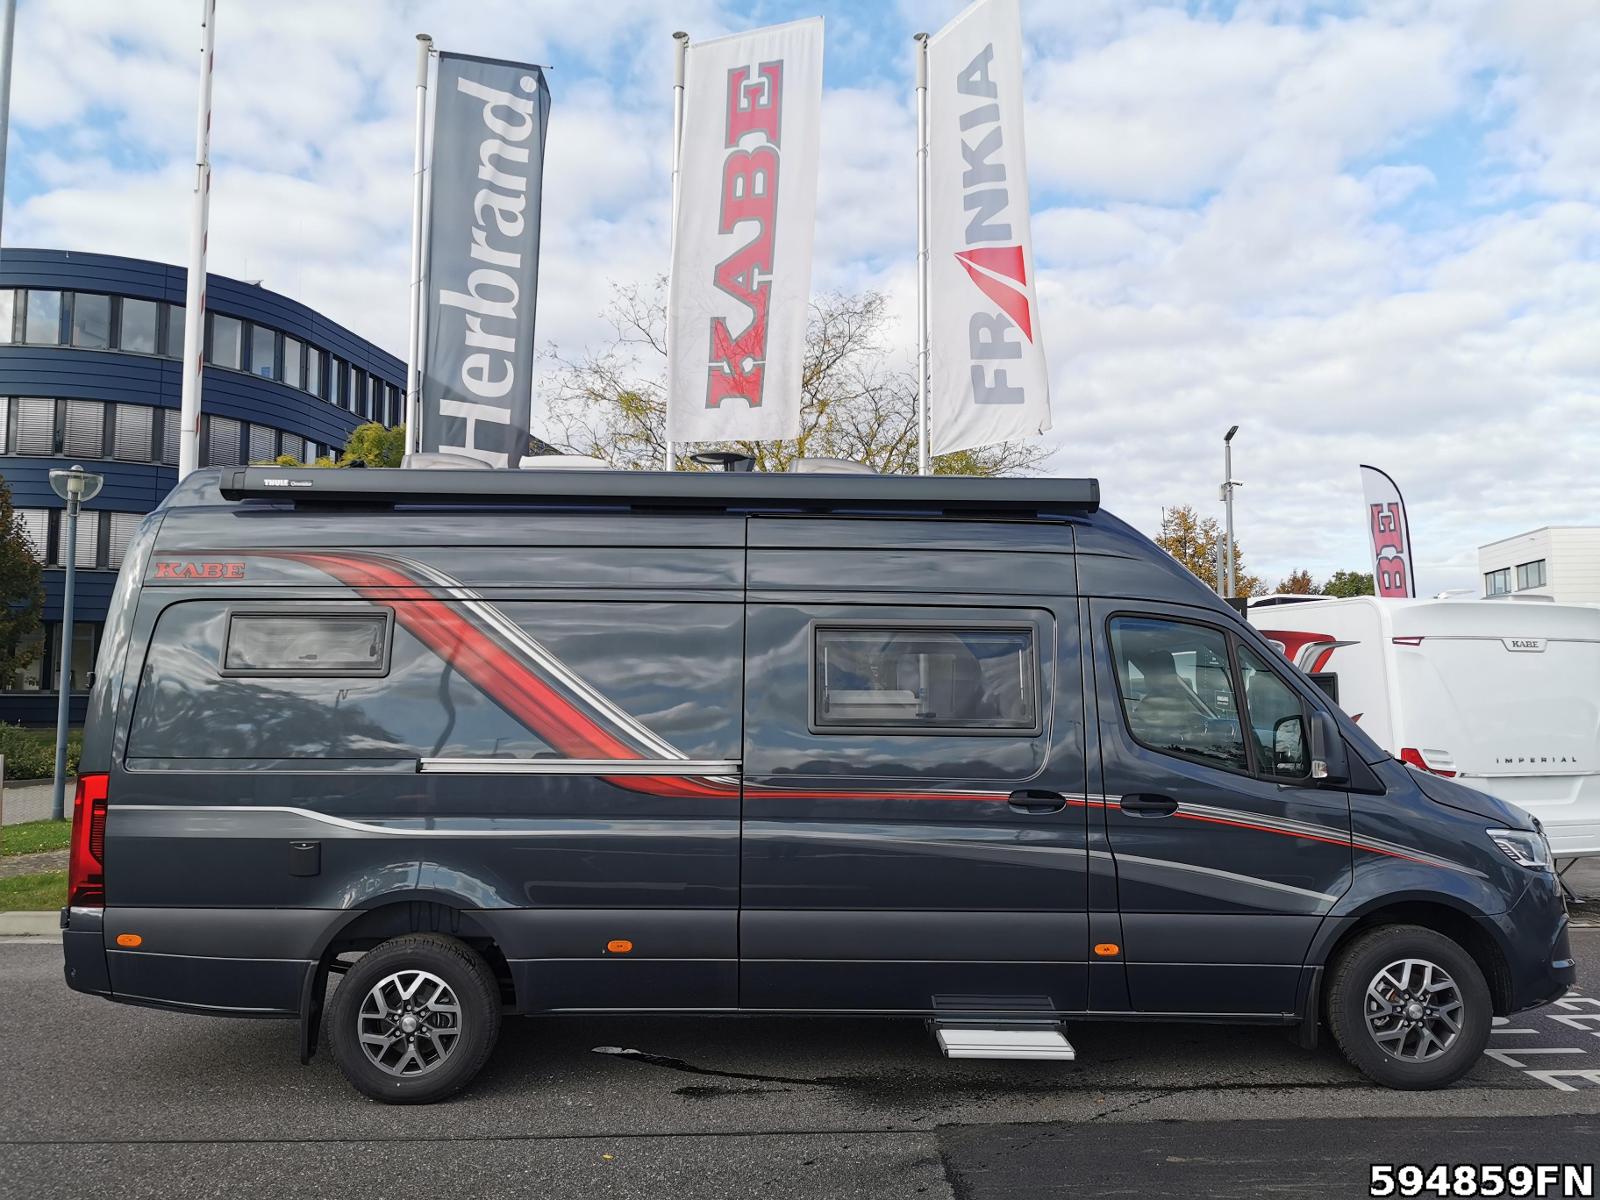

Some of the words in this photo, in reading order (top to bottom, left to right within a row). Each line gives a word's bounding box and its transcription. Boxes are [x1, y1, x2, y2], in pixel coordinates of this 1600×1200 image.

[439, 75, 537, 469] Herbrand.
[705, 59, 784, 409] KABE
[954, 42, 1032, 405] FRANKIA
[154, 562, 246, 579] KABE
[1511, 640, 1539, 648] KABE
[1496, 756, 1577, 764] IMPERIAL
